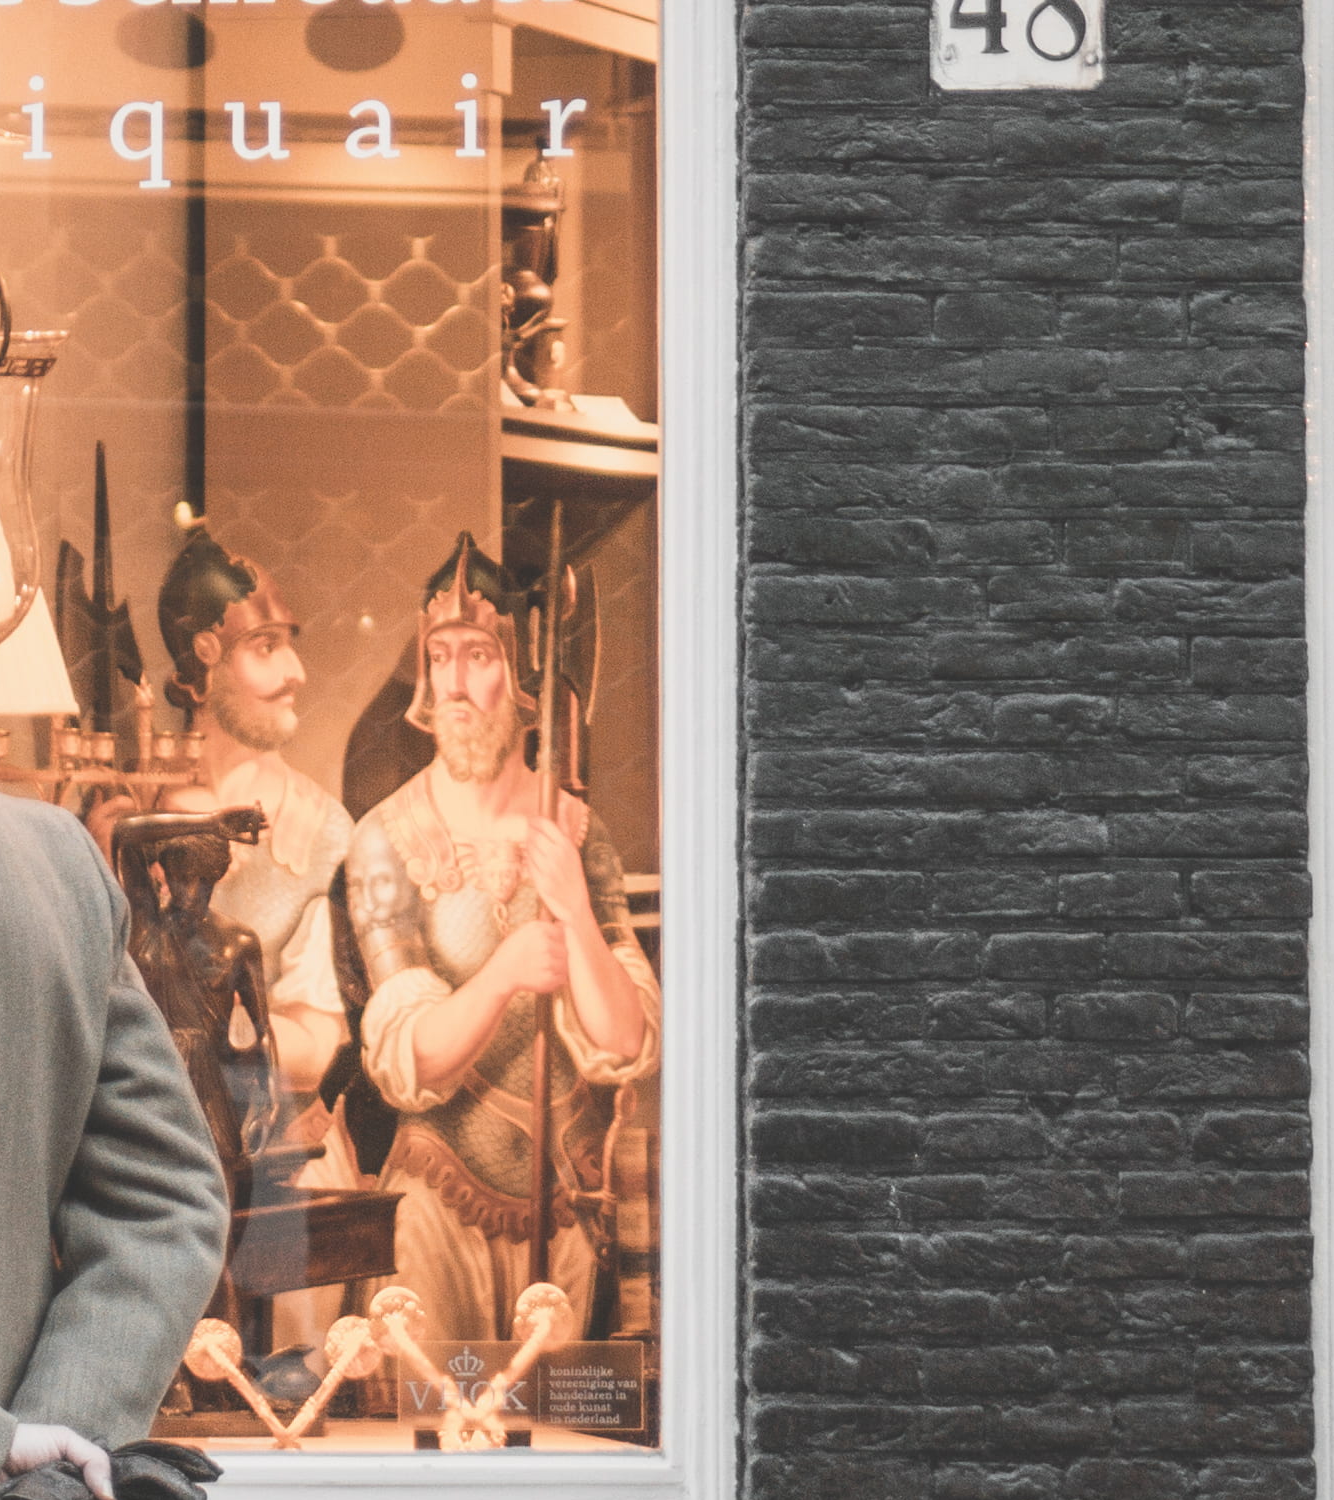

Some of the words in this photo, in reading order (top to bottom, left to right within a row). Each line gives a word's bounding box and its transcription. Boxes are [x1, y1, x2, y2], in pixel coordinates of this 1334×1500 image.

[549, 1365, 614, 1378] koninklijke
[549, 1379, 615, 1390] vereeniging
[617, 1380, 638, 1389] van
[405, 1381, 528, 1411] VHOK
[549, 1390, 613, 1401] handelaren
[615, 1390, 627, 1401] in
[549, 1401, 577, 1412] oude
[579, 1401, 612, 1412] kunst
[564, 1413, 620, 1425] nederland
